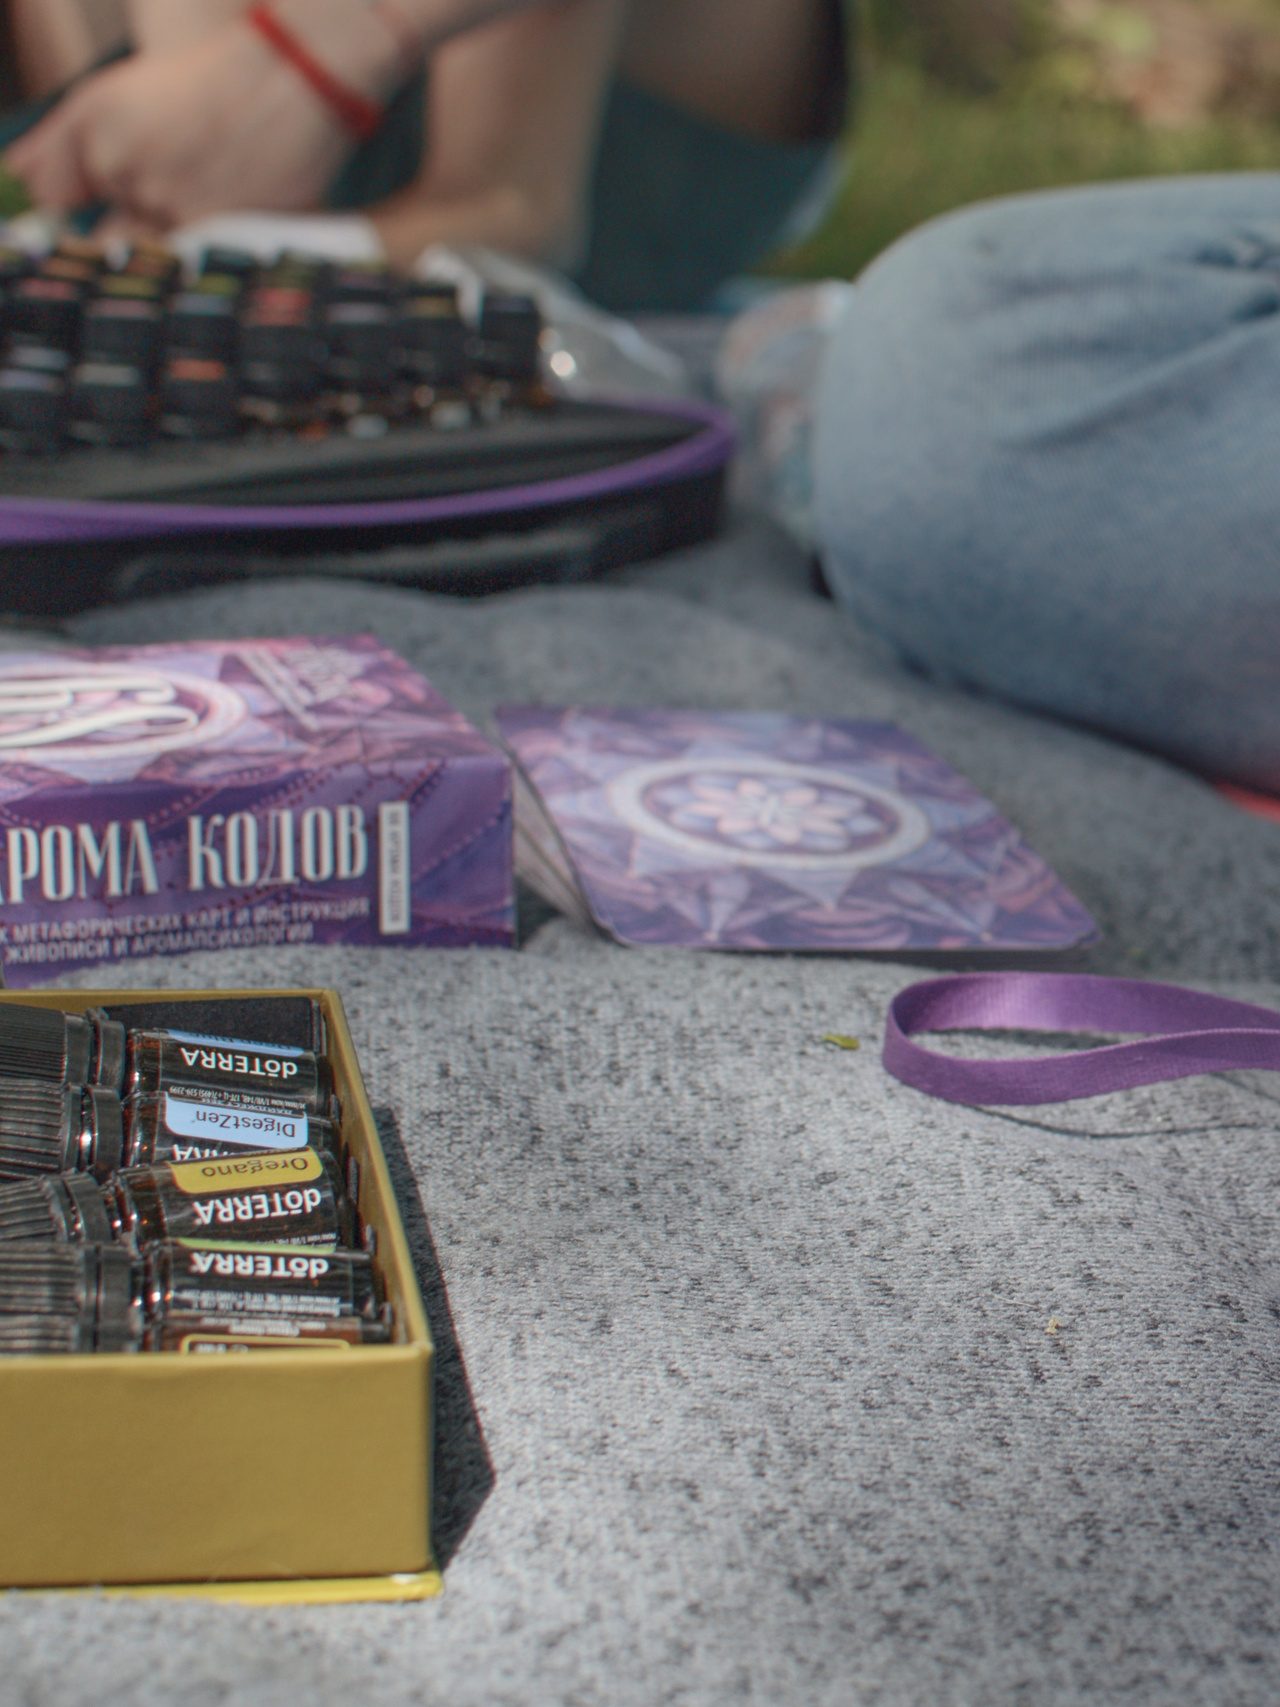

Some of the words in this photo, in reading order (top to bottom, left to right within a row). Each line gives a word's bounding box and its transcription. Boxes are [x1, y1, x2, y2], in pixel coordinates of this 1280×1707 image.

[0, 818, 160, 904] РОМА
[187, 803, 369, 890] КОДОВ
[12, 914, 182, 943] МЕТАФОРИЧЕСКИХ
[187, 906, 233, 930] КАРТ
[236, 905, 252, 926] И
[254, 897, 370, 924] ИНСТРУКЦИЯ
[114, 936, 128, 956] И
[196, 1110, 296, 1138] DigestZen
[201, 1156, 309, 1178] Oregano
